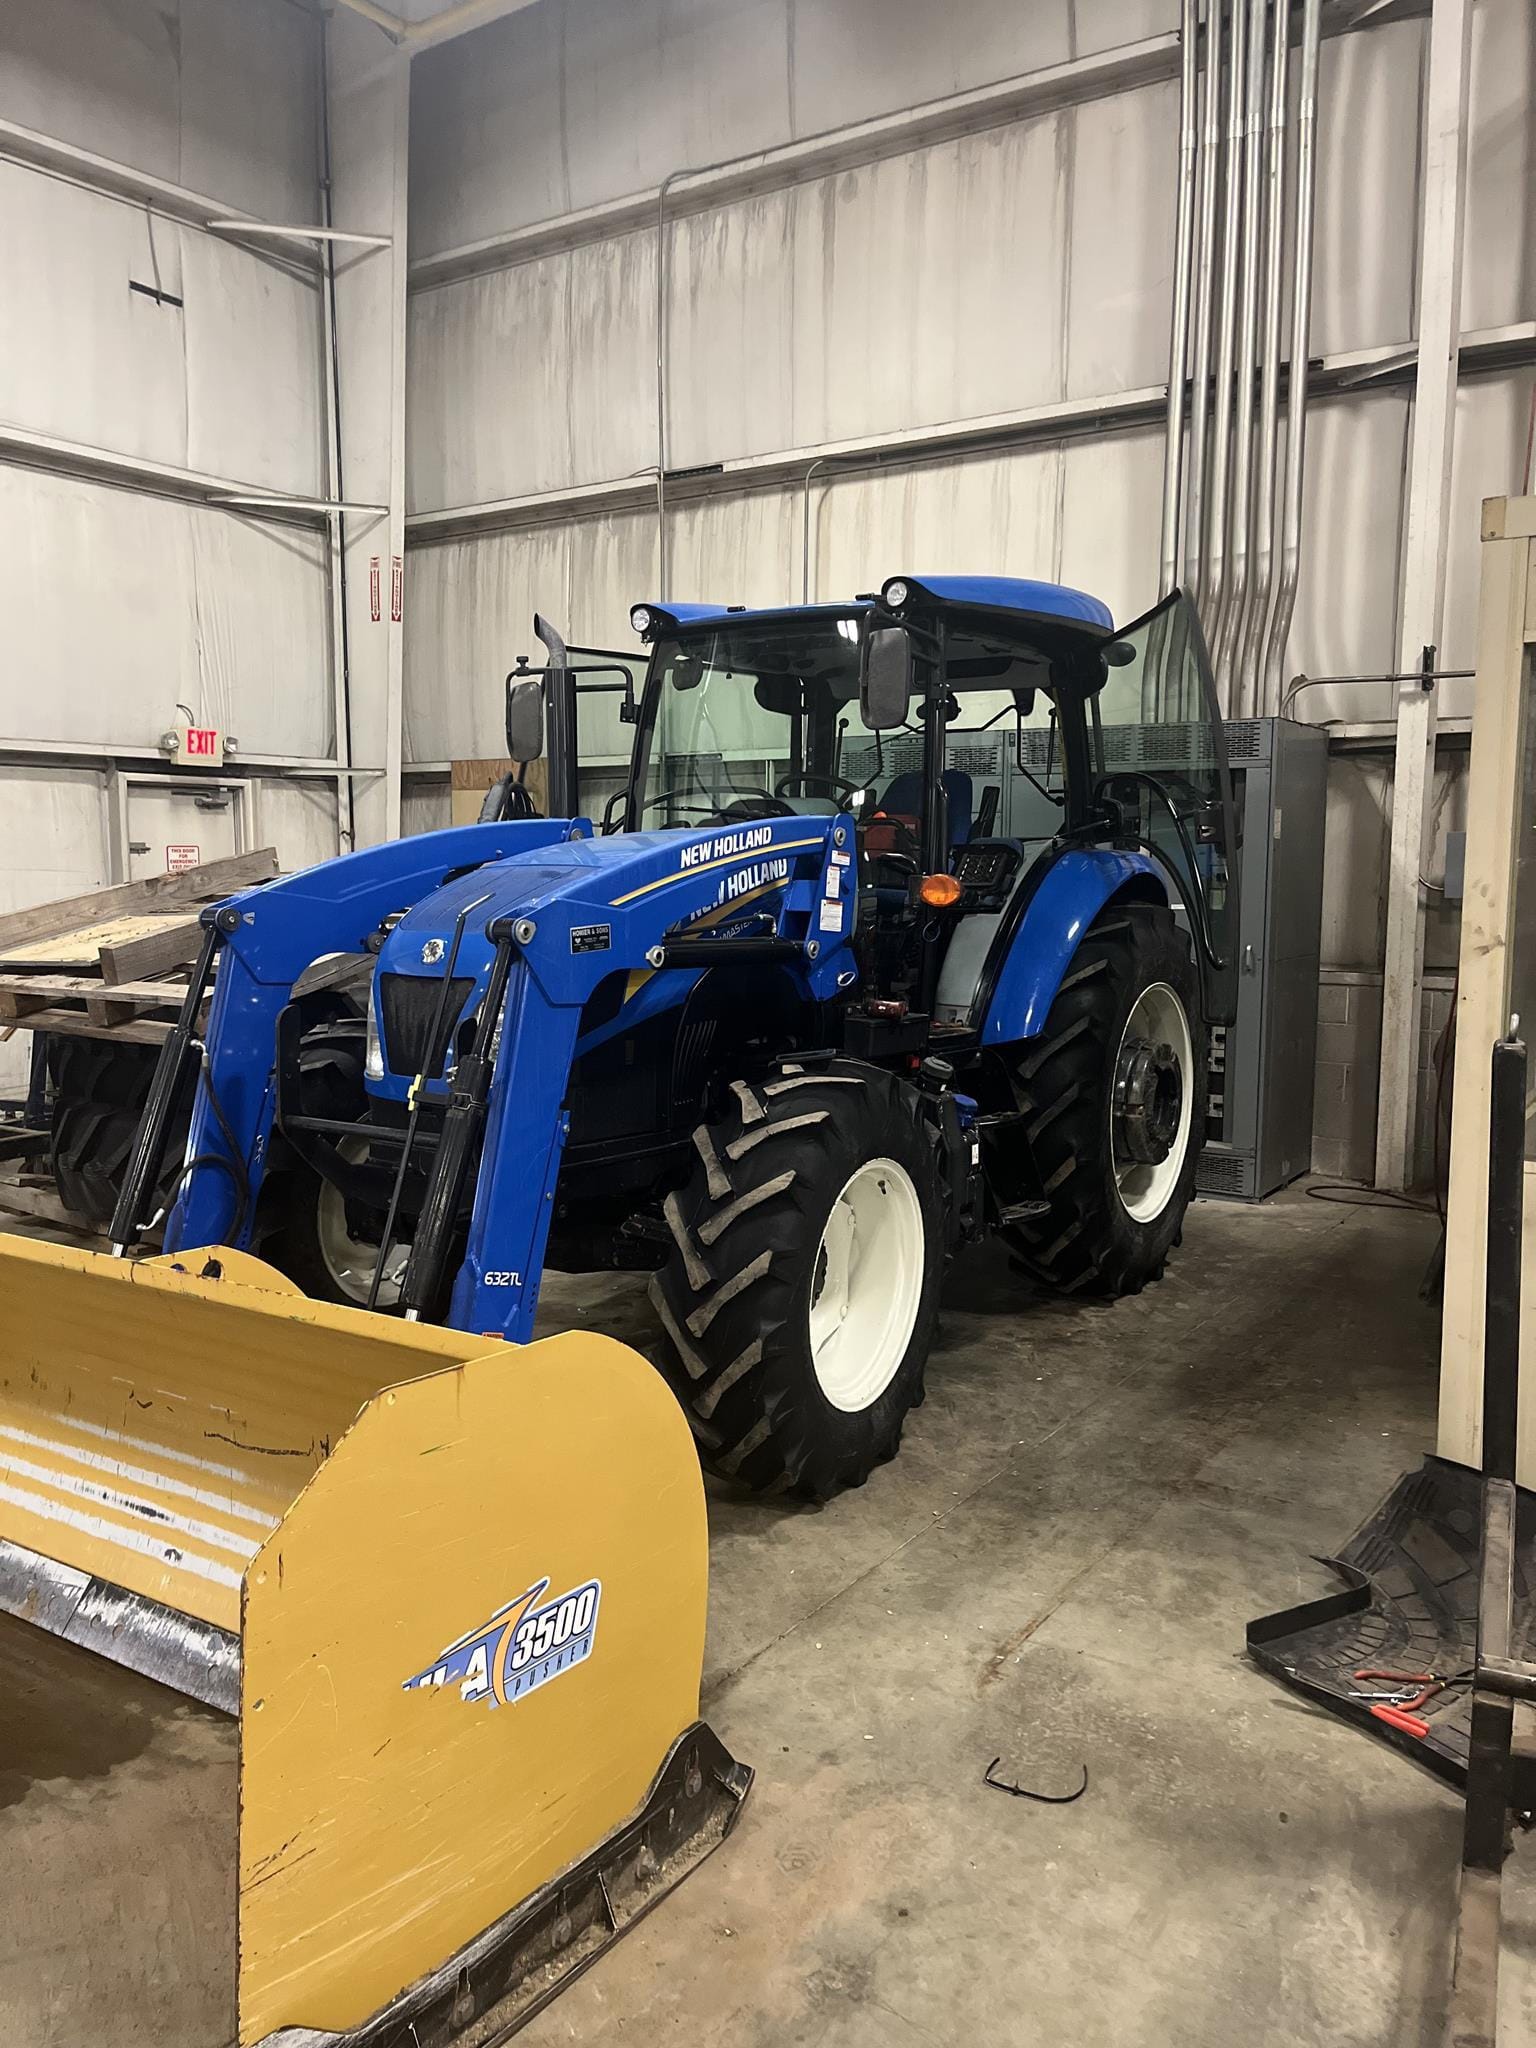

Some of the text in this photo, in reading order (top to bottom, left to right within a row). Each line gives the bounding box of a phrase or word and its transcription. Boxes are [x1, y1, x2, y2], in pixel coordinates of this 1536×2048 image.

[188, 729, 217, 755] EXIT
[681, 826, 772, 868] NEW HOLLAND
[727, 859, 788, 899] HOLLAND
[484, 1271, 522, 1286] 632TL
[511, 1587, 597, 1671] 3500
[514, 1639, 589, 1696] PUSHER
